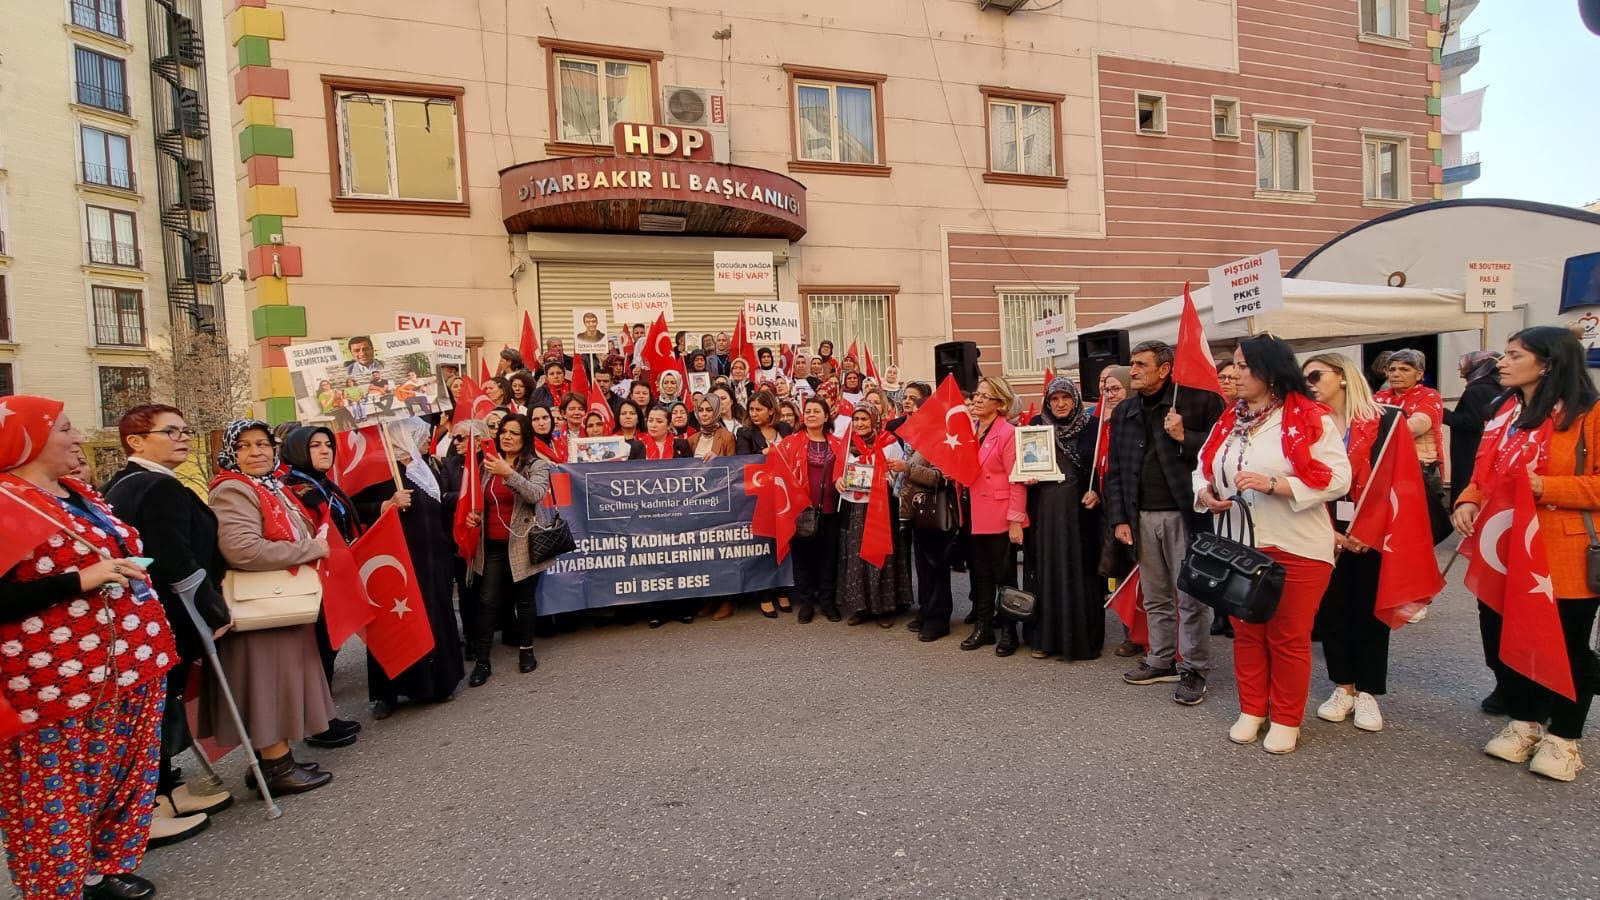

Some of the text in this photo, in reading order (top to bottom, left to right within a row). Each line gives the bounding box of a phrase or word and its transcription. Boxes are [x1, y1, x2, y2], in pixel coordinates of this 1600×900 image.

[624, 124, 704, 157] HDP
[518, 170, 653, 201] DİYARBAKIR
[689, 174, 800, 216] BAŞKANLIĞI
[1469, 262, 1512, 270] NE SOUTENEZ
[718, 271, 731, 279] NE
[745, 271, 769, 280] VAR?
[616, 302, 630, 310] NE
[645, 301, 668, 309] VAR?
[748, 303, 778, 312] HALK
[1482, 300, 1496, 308] YPG
[398, 316, 462, 336] EVLAT
[748, 315, 798, 328] DÜŞMANI
[749, 330, 782, 341] PARTİ
[610, 475, 707, 496] SEKADER
[599, 496, 719, 512] seçilmiş kadınlar derneği
[567, 525, 754, 555] EÇİLMİŞ KADINLAR DERNEĞİ
[630, 546, 715, 566] ANNELERİNİN
[719, 543, 771, 559] YANINDA
[615, 574, 710, 594] EDİ BESE BESE
